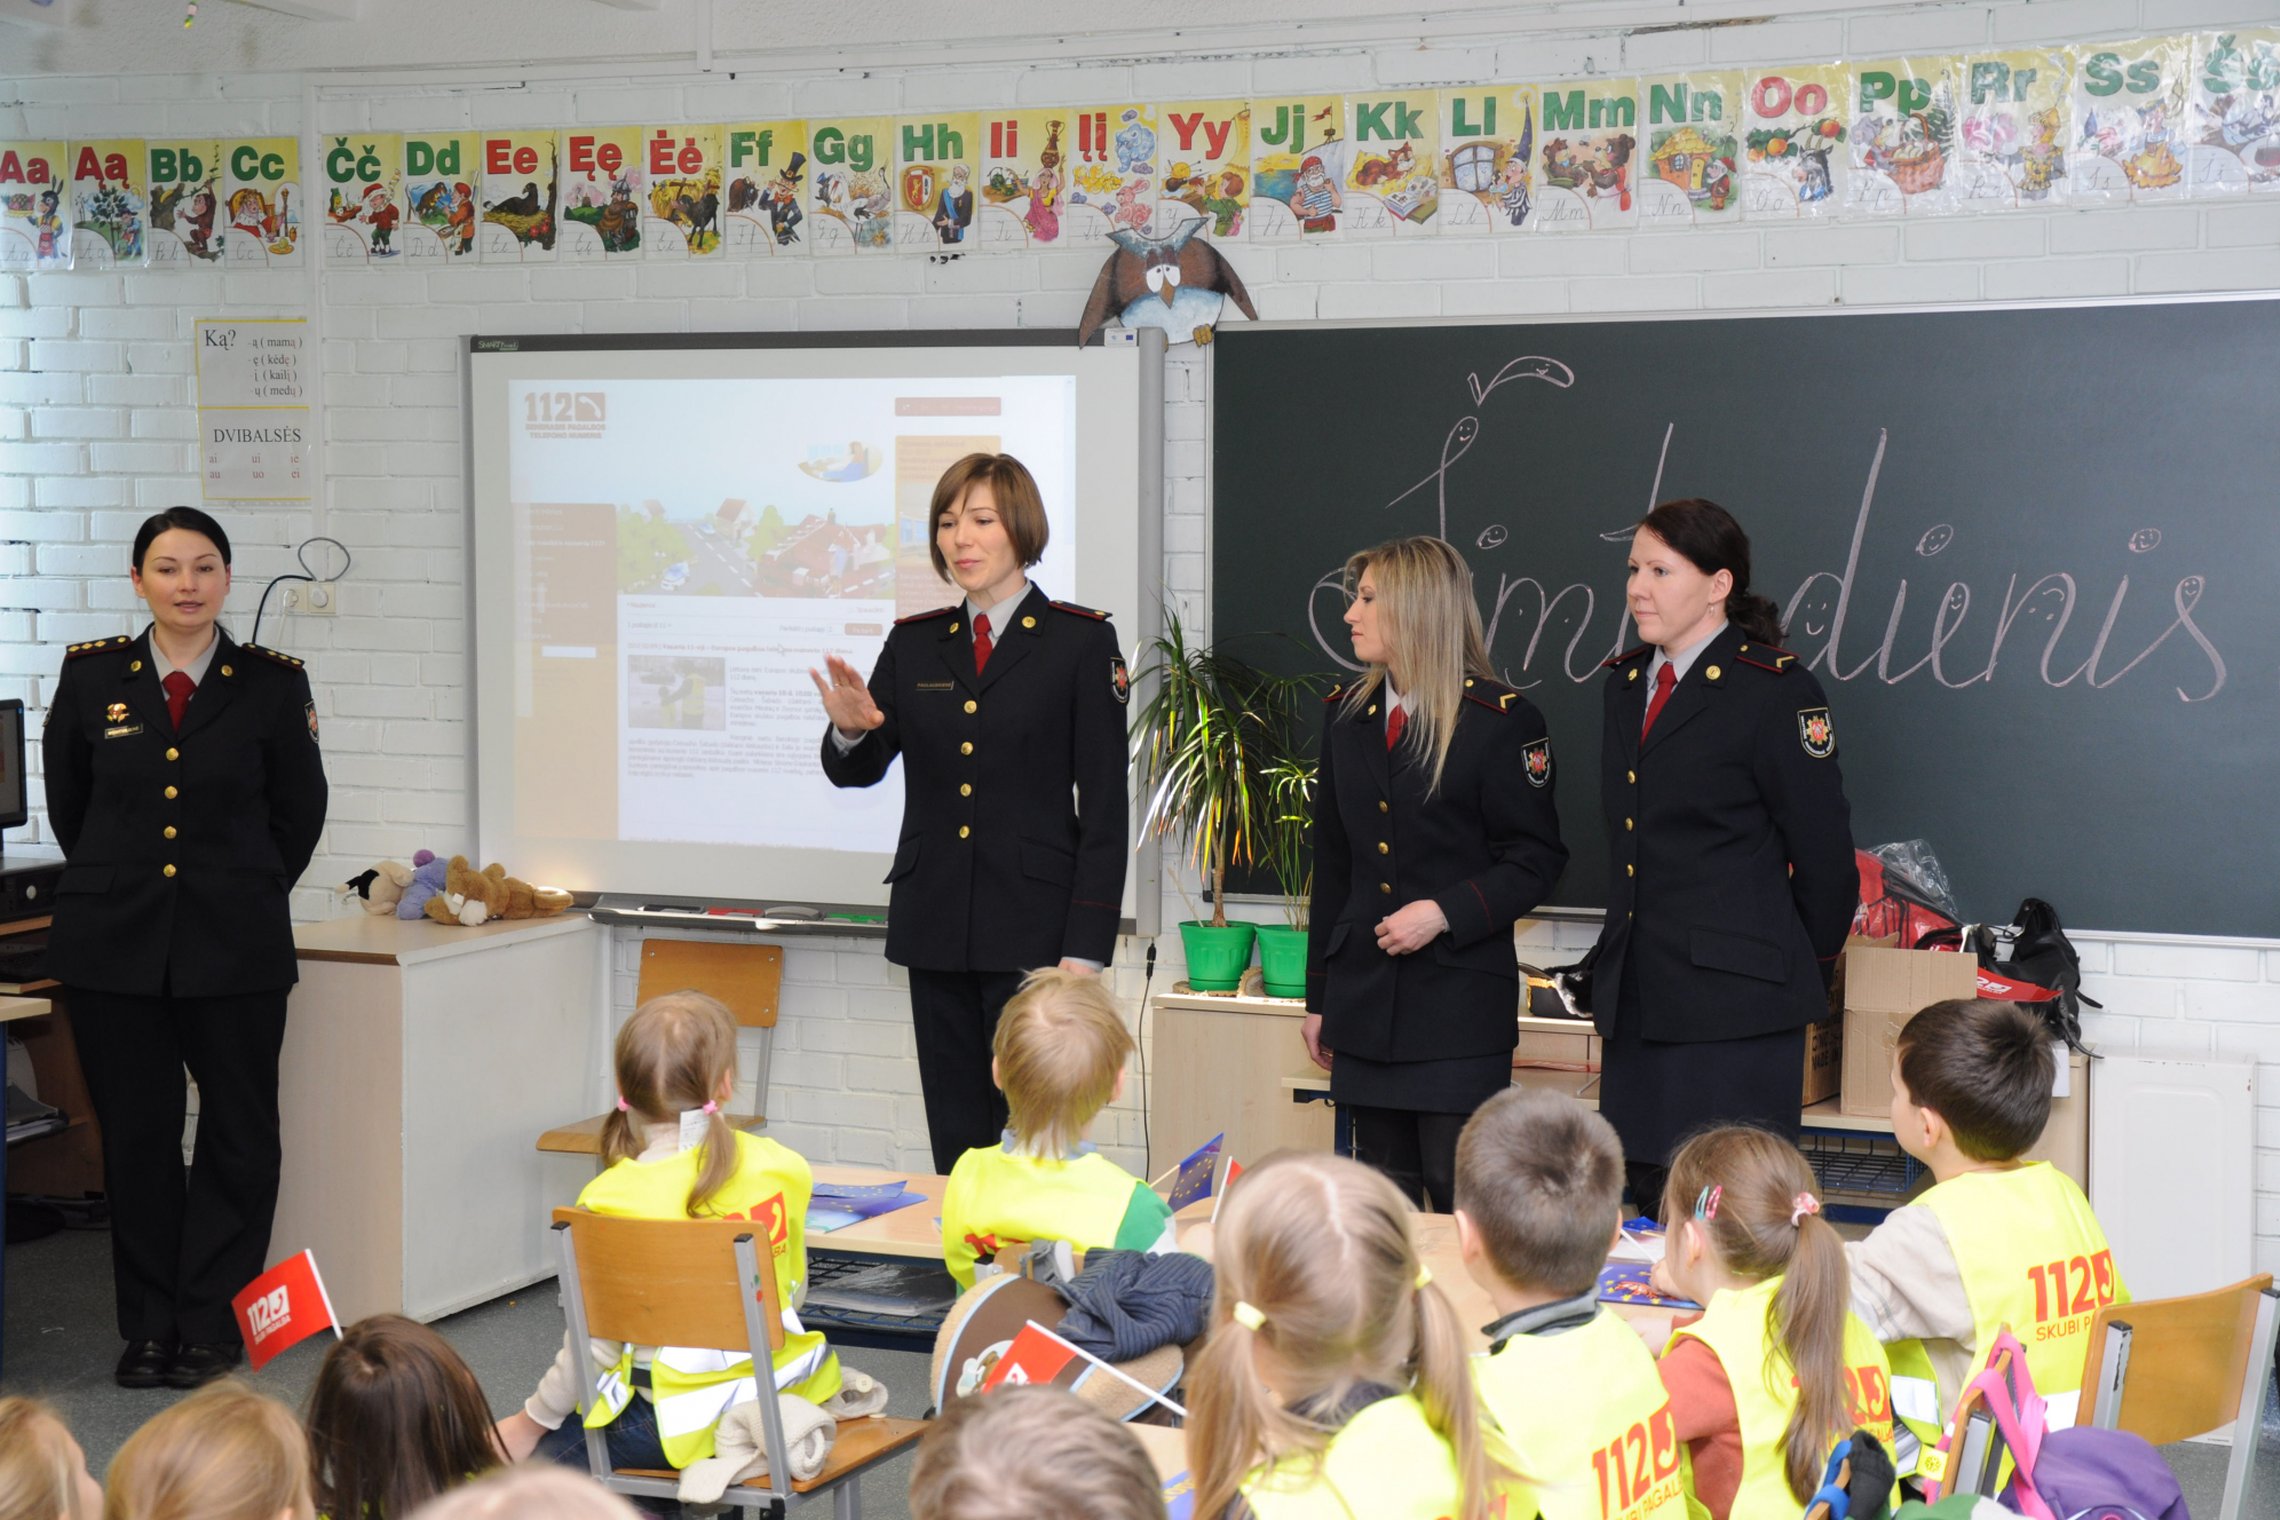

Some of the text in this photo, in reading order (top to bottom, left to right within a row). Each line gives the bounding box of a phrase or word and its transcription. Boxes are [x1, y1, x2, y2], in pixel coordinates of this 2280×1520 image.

[1860, 72, 1932, 117] Pp
[1971, 61, 2037, 104] Rr
[2084, 53, 2160, 96] Ss
[1452, 97, 1497, 137] Ll
[1543, 90, 1636, 131] Mm
[1650, 84, 1723, 124] Nn
[1752, 76, 1828, 119] Oo
[902, 123, 963, 161] Hh
[990, 120, 1018, 158] Ii
[1078, 112, 1108, 162] Įį
[1168, 112, 1231, 160] Yy
[1261, 104, 1305, 154] Jj
[1356, 101, 1424, 142] Kk
[0, 147, 49, 184] Aa
[74, 146, 129, 190] Ąą
[151, 148, 203, 183] Bb
[231, 145, 285, 181] Cc
[326, 137, 381, 183] Čč
[406, 140, 460, 177] Dd
[486, 140, 538, 175] Ee
[569, 136, 622, 181] Ęę
[650, 130, 703, 175] Ėė
[730, 130, 773, 167] Ff
[813, 127, 873, 173] Gg
[205, 329, 236, 350] Ką?
[524, 392, 572, 421] 112
[213, 425, 302, 443] DVIBALSĖS
[2028, 1256, 2096, 1323] 112
[247, 1296, 271, 1336] 112
[2036, 1318, 2080, 1341] SKUBI
[1592, 1422, 1651, 1520] 112
